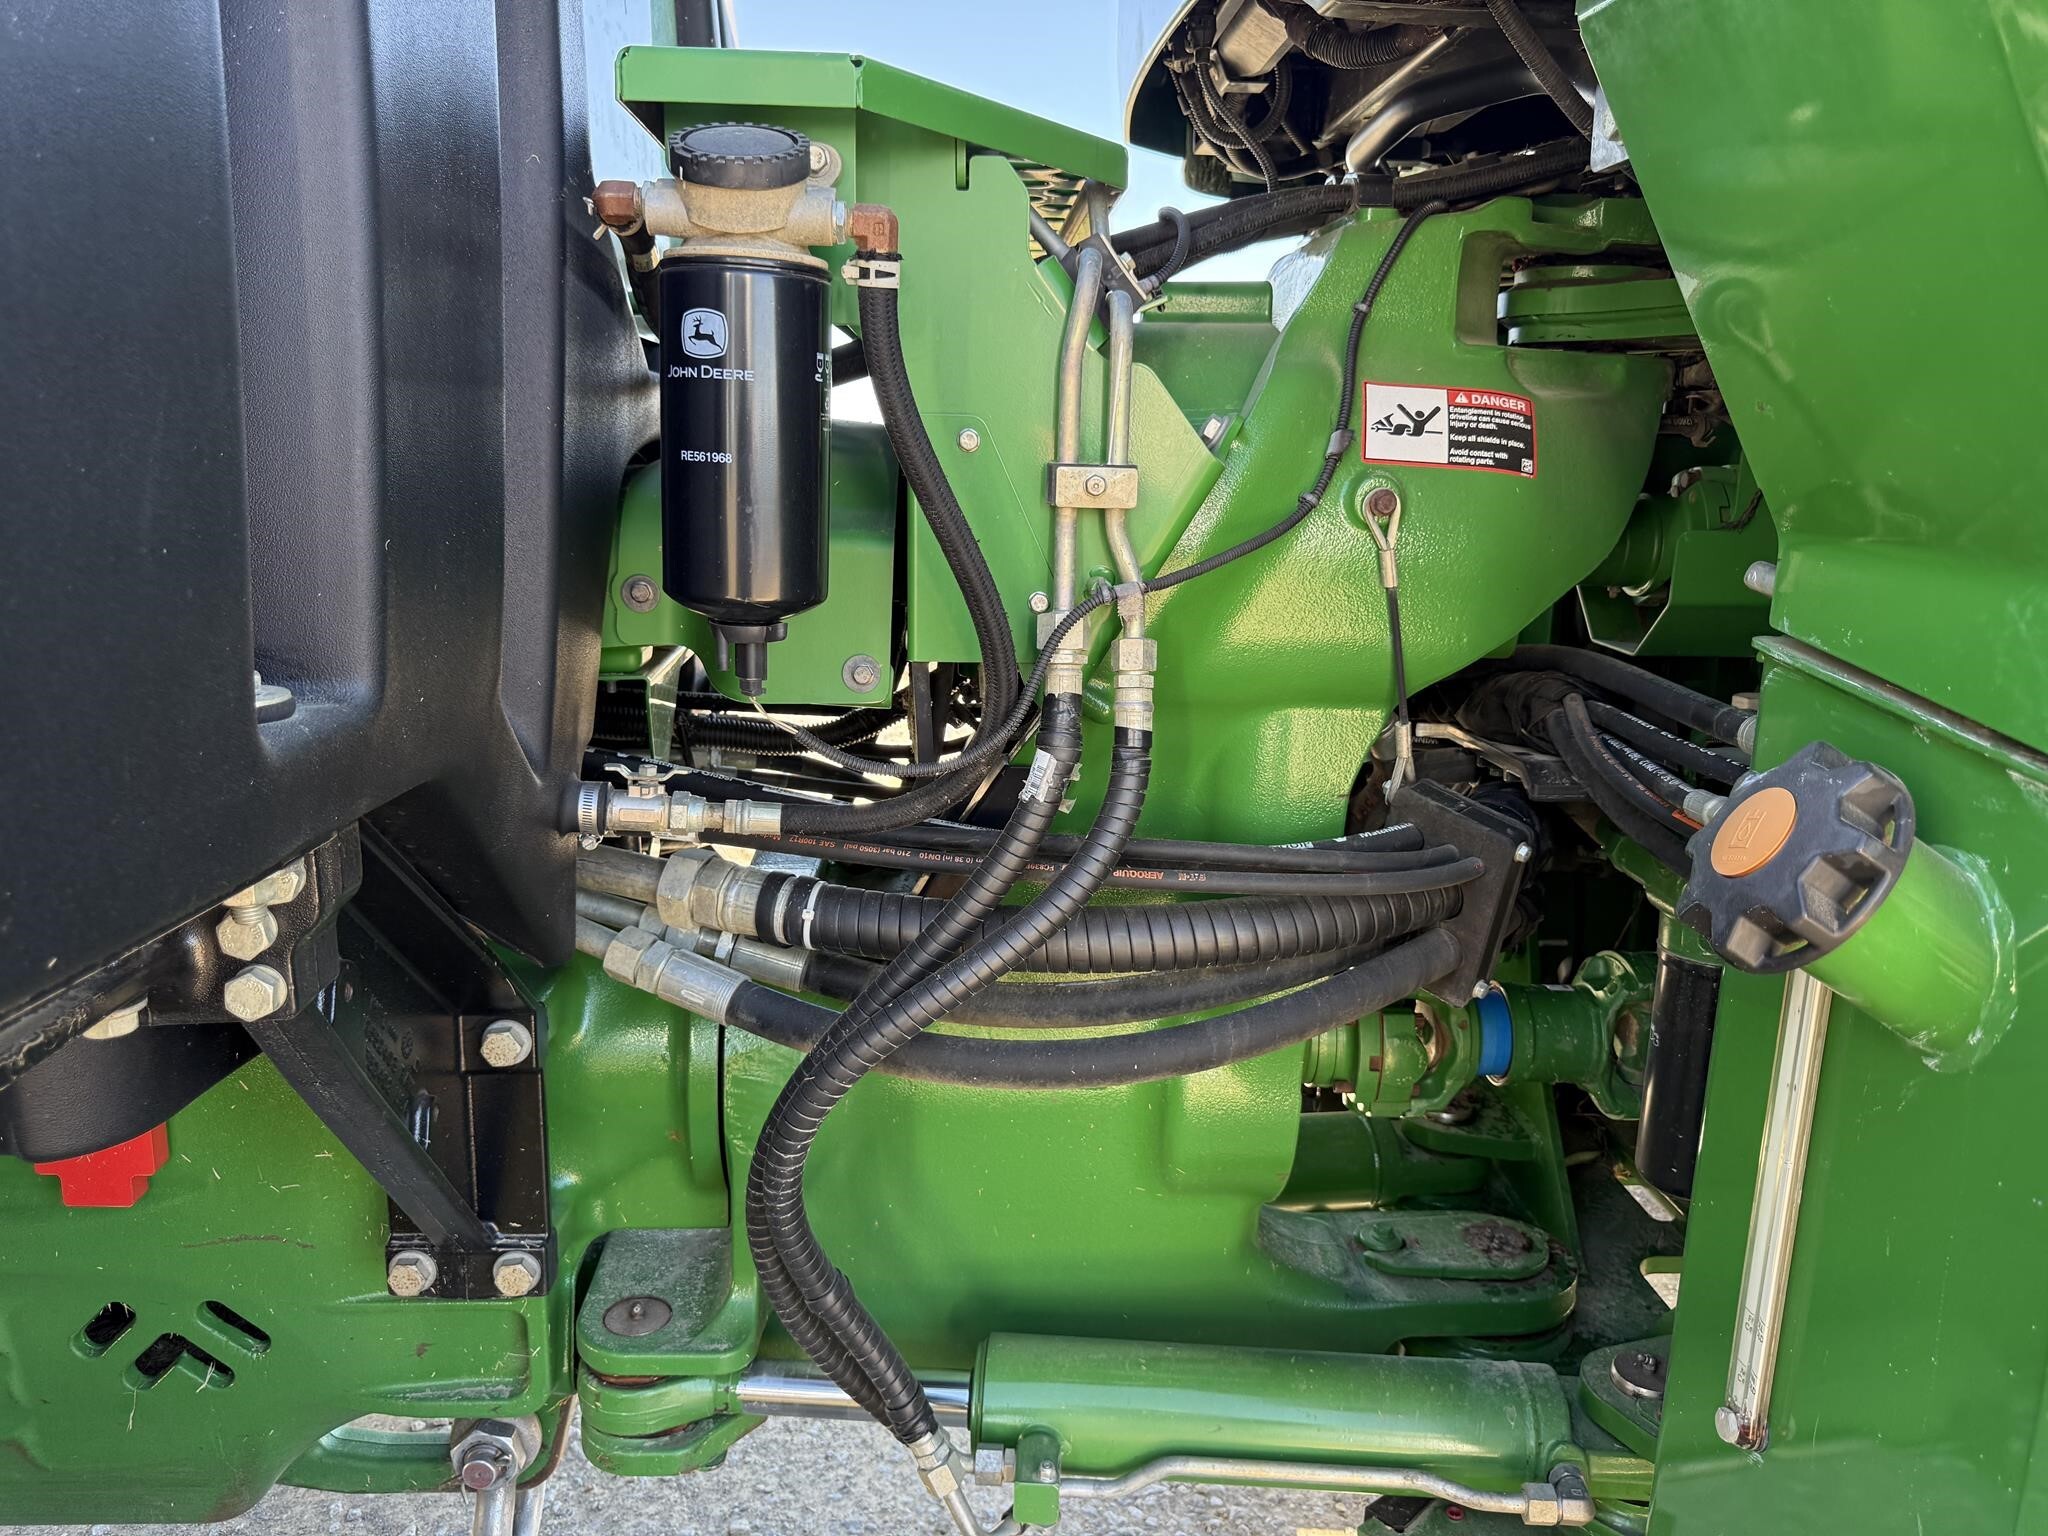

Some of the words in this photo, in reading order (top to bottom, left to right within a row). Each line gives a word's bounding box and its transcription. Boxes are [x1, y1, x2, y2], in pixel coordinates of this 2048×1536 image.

[1471, 394, 1526, 412] DANGER
[1449, 406, 1494, 417] Entanglement
[1501, 411, 1525, 422] rotating
[1449, 413, 1478, 421] driveline
[1491, 417, 1510, 425] cause
[1510, 420, 1532, 430] serious
[1449, 420, 1469, 429] injury
[1477, 422, 1498, 430] death.
[1449, 433, 1467, 442] Keep
[1467, 434, 1477, 442] all
[1477, 435, 1501, 445] shields
[1508, 440, 1526, 449] place.
[680, 450, 733, 464] RE561968
[1449, 447, 1469, 456] Avoid
[1469, 449, 1494, 458] contact
[1494, 452, 1509, 460] with
[1449, 456, 1475, 465] rotating
[1475, 458, 1495, 466] parts.
[788, 836, 816, 845] 100R17
[818, 840, 836, 849] SAE
[859, 845, 881, 854] (3050
[881, 847, 896, 856] bar
[919, 851, 942, 861] DN10
[1112, 869, 1164, 880] AEROQUIP
